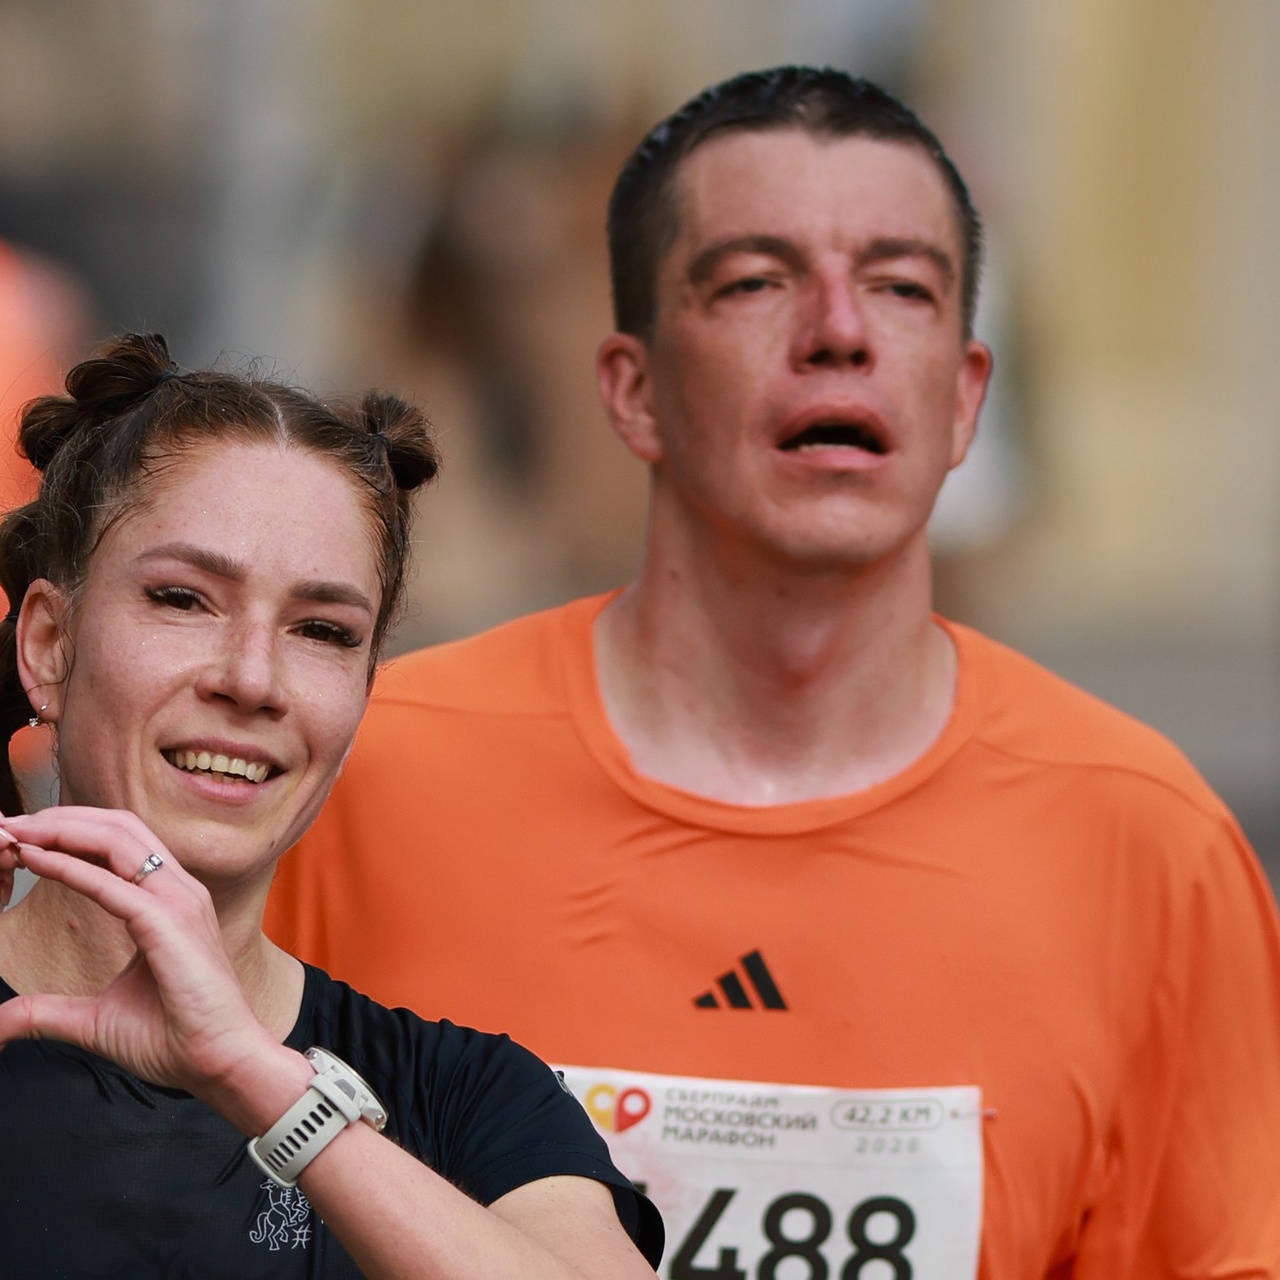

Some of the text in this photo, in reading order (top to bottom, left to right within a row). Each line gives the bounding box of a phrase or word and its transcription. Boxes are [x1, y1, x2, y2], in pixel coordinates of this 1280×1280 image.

[663, 1105, 818, 1131] МОСКОВСКИЙ
[899, 1105, 932, 1124] КМ
[661, 1125, 776, 1148] МАРАФОН
